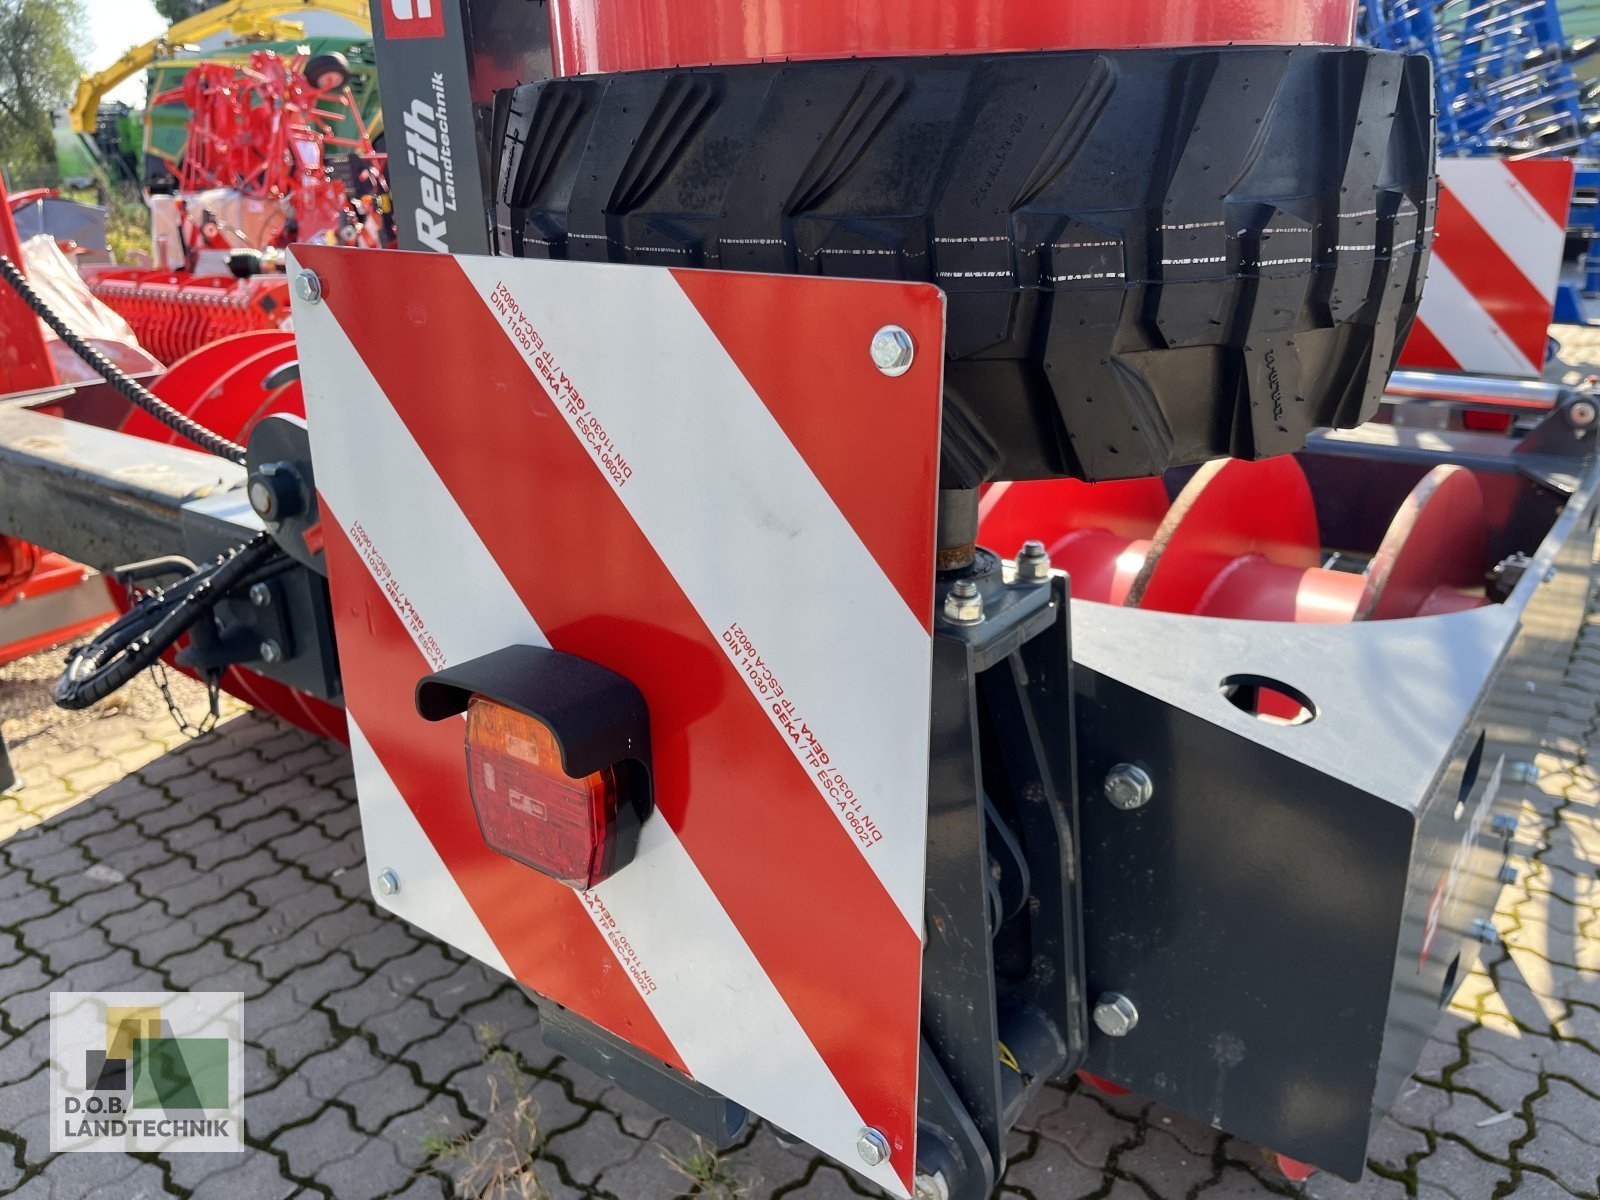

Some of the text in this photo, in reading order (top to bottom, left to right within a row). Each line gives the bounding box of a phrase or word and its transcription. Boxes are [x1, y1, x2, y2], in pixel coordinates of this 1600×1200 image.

[432, 72, 456, 211] Landtechnik
[403, 99, 449, 254] Reith
[496, 281, 519, 314] 06021
[518, 312, 543, 350] ESC-A
[542, 351, 554, 366] TP
[490, 292, 507, 315] DIN
[507, 316, 531, 350] 11030
[535, 357, 560, 395] GEKA
[565, 399, 578, 416] TP
[576, 416, 600, 455] ESC-A
[601, 453, 625, 487] 06021
[560, 372, 585, 410] GEKA
[589, 418, 614, 452] 11030
[614, 453, 632, 478] DIN
[354, 521, 371, 547] 06021
[372, 547, 391, 578] ESC-A
[350, 528, 363, 546] DIN
[364, 549, 382, 577] 11030
[385, 583, 405, 614] GEKA
[410, 620, 419, 633] TP
[418, 633, 438, 667] ESC-A
[390, 579, 400, 593] TP
[404, 598, 424, 629] GEKA
[428, 636, 446, 665] 11030
[730, 623, 757, 657] 06021
[755, 656, 784, 697] ESC-A
[781, 699, 795, 716] TP
[722, 631, 741, 656] DIN
[741, 657, 768, 694] 11030
[772, 703, 800, 744] GEKA
[806, 750, 819, 768] TP
[817, 769, 846, 812] ESC-A
[846, 812, 873, 848] 06021
[802, 723, 829, 765] GEKA
[834, 775, 862, 813] 11030
[862, 815, 883, 842] DIN
[594, 894, 616, 928] GEKA
[583, 890, 593, 909] KA
[599, 917, 609, 930] TP
[608, 932, 630, 965] ESC-A
[630, 966, 651, 995] 06021
[620, 936, 641, 968] 11030
[641, 970, 657, 991] DIN
